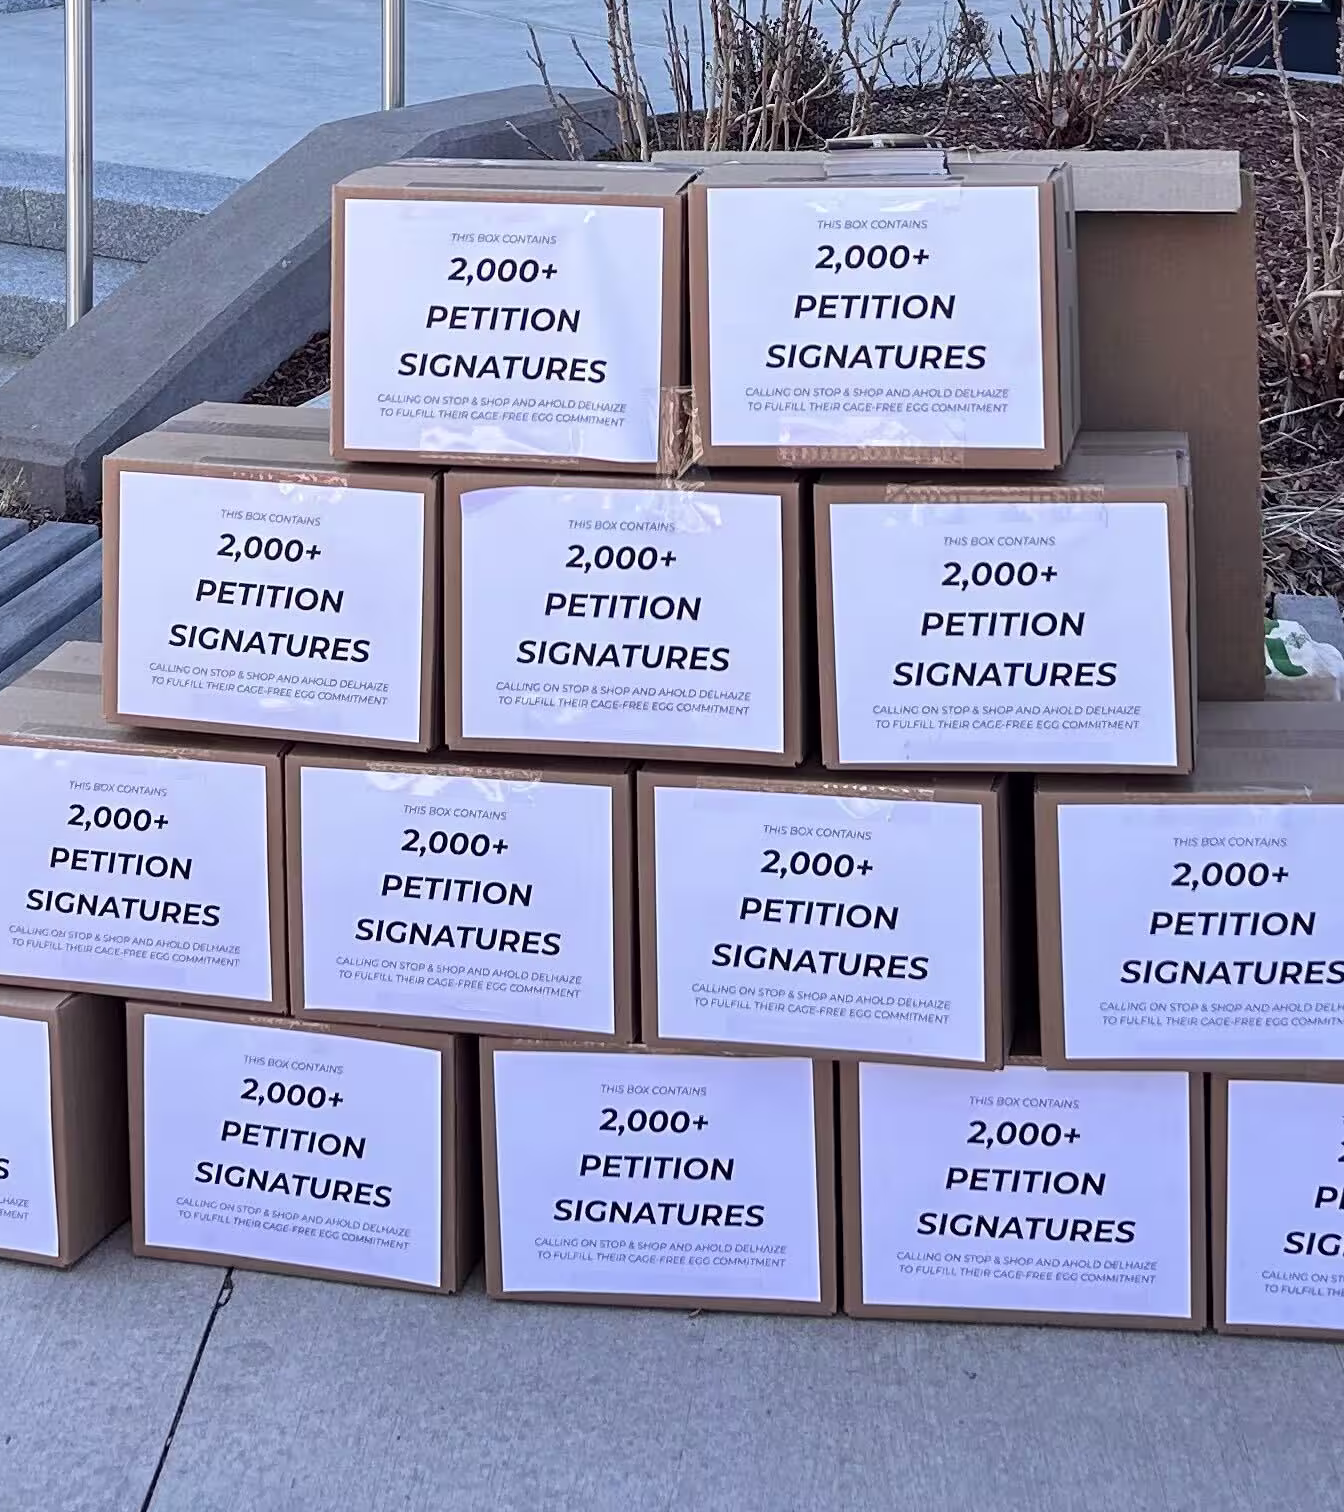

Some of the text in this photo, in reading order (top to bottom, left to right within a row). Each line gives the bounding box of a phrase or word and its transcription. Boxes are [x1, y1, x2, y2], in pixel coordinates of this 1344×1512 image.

[817, 219, 928, 229] THIS BOX CONTAINS
[451, 232, 557, 244] THIS BOX CONTAINS
[448, 257, 557, 286] 2,000+
[815, 245, 929, 274] 2,000+
[426, 305, 581, 332] PETITION
[794, 295, 955, 319] PETITION
[397, 353, 608, 382] SIGNATURES
[765, 344, 986, 369] SIGNATURES
[745, 387, 791, 397] CALLING
[793, 388, 810, 397] ON
[812, 387, 841, 397] STOP
[853, 387, 883, 398] SHOP
[885, 388, 910, 397] AND
[912, 388, 952, 398] AHOLD
[954, 388, 1008, 398] DELHAIZE
[748, 401, 1008, 413] TO FULFILL THEIR CAGE-FREE EGG COMMITMENT
[220, 510, 321, 526] THIS BOX CONTAINS
[568, 520, 675, 531] THIS BOX CONTAINS
[216, 534, 321, 562] 2,000+
[943, 536, 1055, 546] THIS BOX CONTAINS
[565, 544, 676, 573] 2,000+
[941, 562, 1057, 591] 2,000+
[196, 579, 343, 613] PETITION
[545, 593, 701, 621] PETITION
[921, 612, 1084, 636] PETITION
[168, 624, 370, 662] SIGNATURES
[516, 640, 730, 671] SIGNATURES
[893, 662, 1116, 686] SIGNATURES
[872, 705, 919, 715] CALLING
[922, 706, 938, 714] ON
[941, 705, 970, 715] STOP
[982, 705, 1013, 715] SHOP
[1015, 706, 1041, 715] AND
[1042, 705, 1083, 715] AHOLD
[1085, 705, 1140, 715] DELHAIZE
[875, 719, 1139, 730] TO FULFILL THEIR CAGE-FREE EGG COMMITMENT
[69, 781, 167, 797] THIS BOX CONTAINS
[67, 804, 168, 831] 2,000+
[403, 805, 507, 820] THIS BOX CONTAINS
[401, 829, 508, 857] 2,000+
[763, 825, 872, 840] THIS BOX CONTAINS
[1173, 837, 1288, 847] THIS BOX CONTAINS
[50, 847, 192, 879] PETITION
[760, 850, 873, 879] 2,000+
[1171, 862, 1289, 891] 2,000+
[381, 874, 532, 906] PETITION
[26, 889, 220, 926] SIGNATURES
[740, 897, 898, 929] PETITION
[355, 918, 560, 955] SIGNATURES
[1150, 912, 1316, 935] PETITION
[712, 943, 928, 980] SIGNATURES
[1100, 1002, 1147, 1012] CALLING
[1150, 1003, 1167, 1011] ON
[1169, 1002, 1199, 1012] STOP
[1211, 1002, 1242, 1012] SHOP
[1244, 1003, 1270, 1011] AND
[1271, 1003, 1312, 1012] AHOLD
[1102, 1016, 1117, 1026] TO
[1119, 1016, 1162, 1026] FULFILL
[1166, 1016, 1198, 1025] THEIR
[1200, 1016, 1262, 1026] CAGE-FREE
[1265, 1016, 1288, 1026] EGG
[243, 1055, 343, 1075] THIS BOX CONTAINS
[240, 1078, 343, 1108] 2,000+
[600, 1085, 707, 1096] THIS BOX CONTAINS
[969, 1096, 1080, 1109] THIS BOX CONTAINS
[599, 1109, 708, 1136] 2,000+
[967, 1121, 1081, 1148] 2,000+
[221, 1120, 365, 1159] PETITION
[580, 1154, 734, 1180] PETITION
[195, 1162, 392, 1207] SIGNATURES
[945, 1167, 1106, 1195] PETITION
[553, 1199, 764, 1227] SIGNATURES
[917, 1213, 1135, 1243] SIGNATURES
